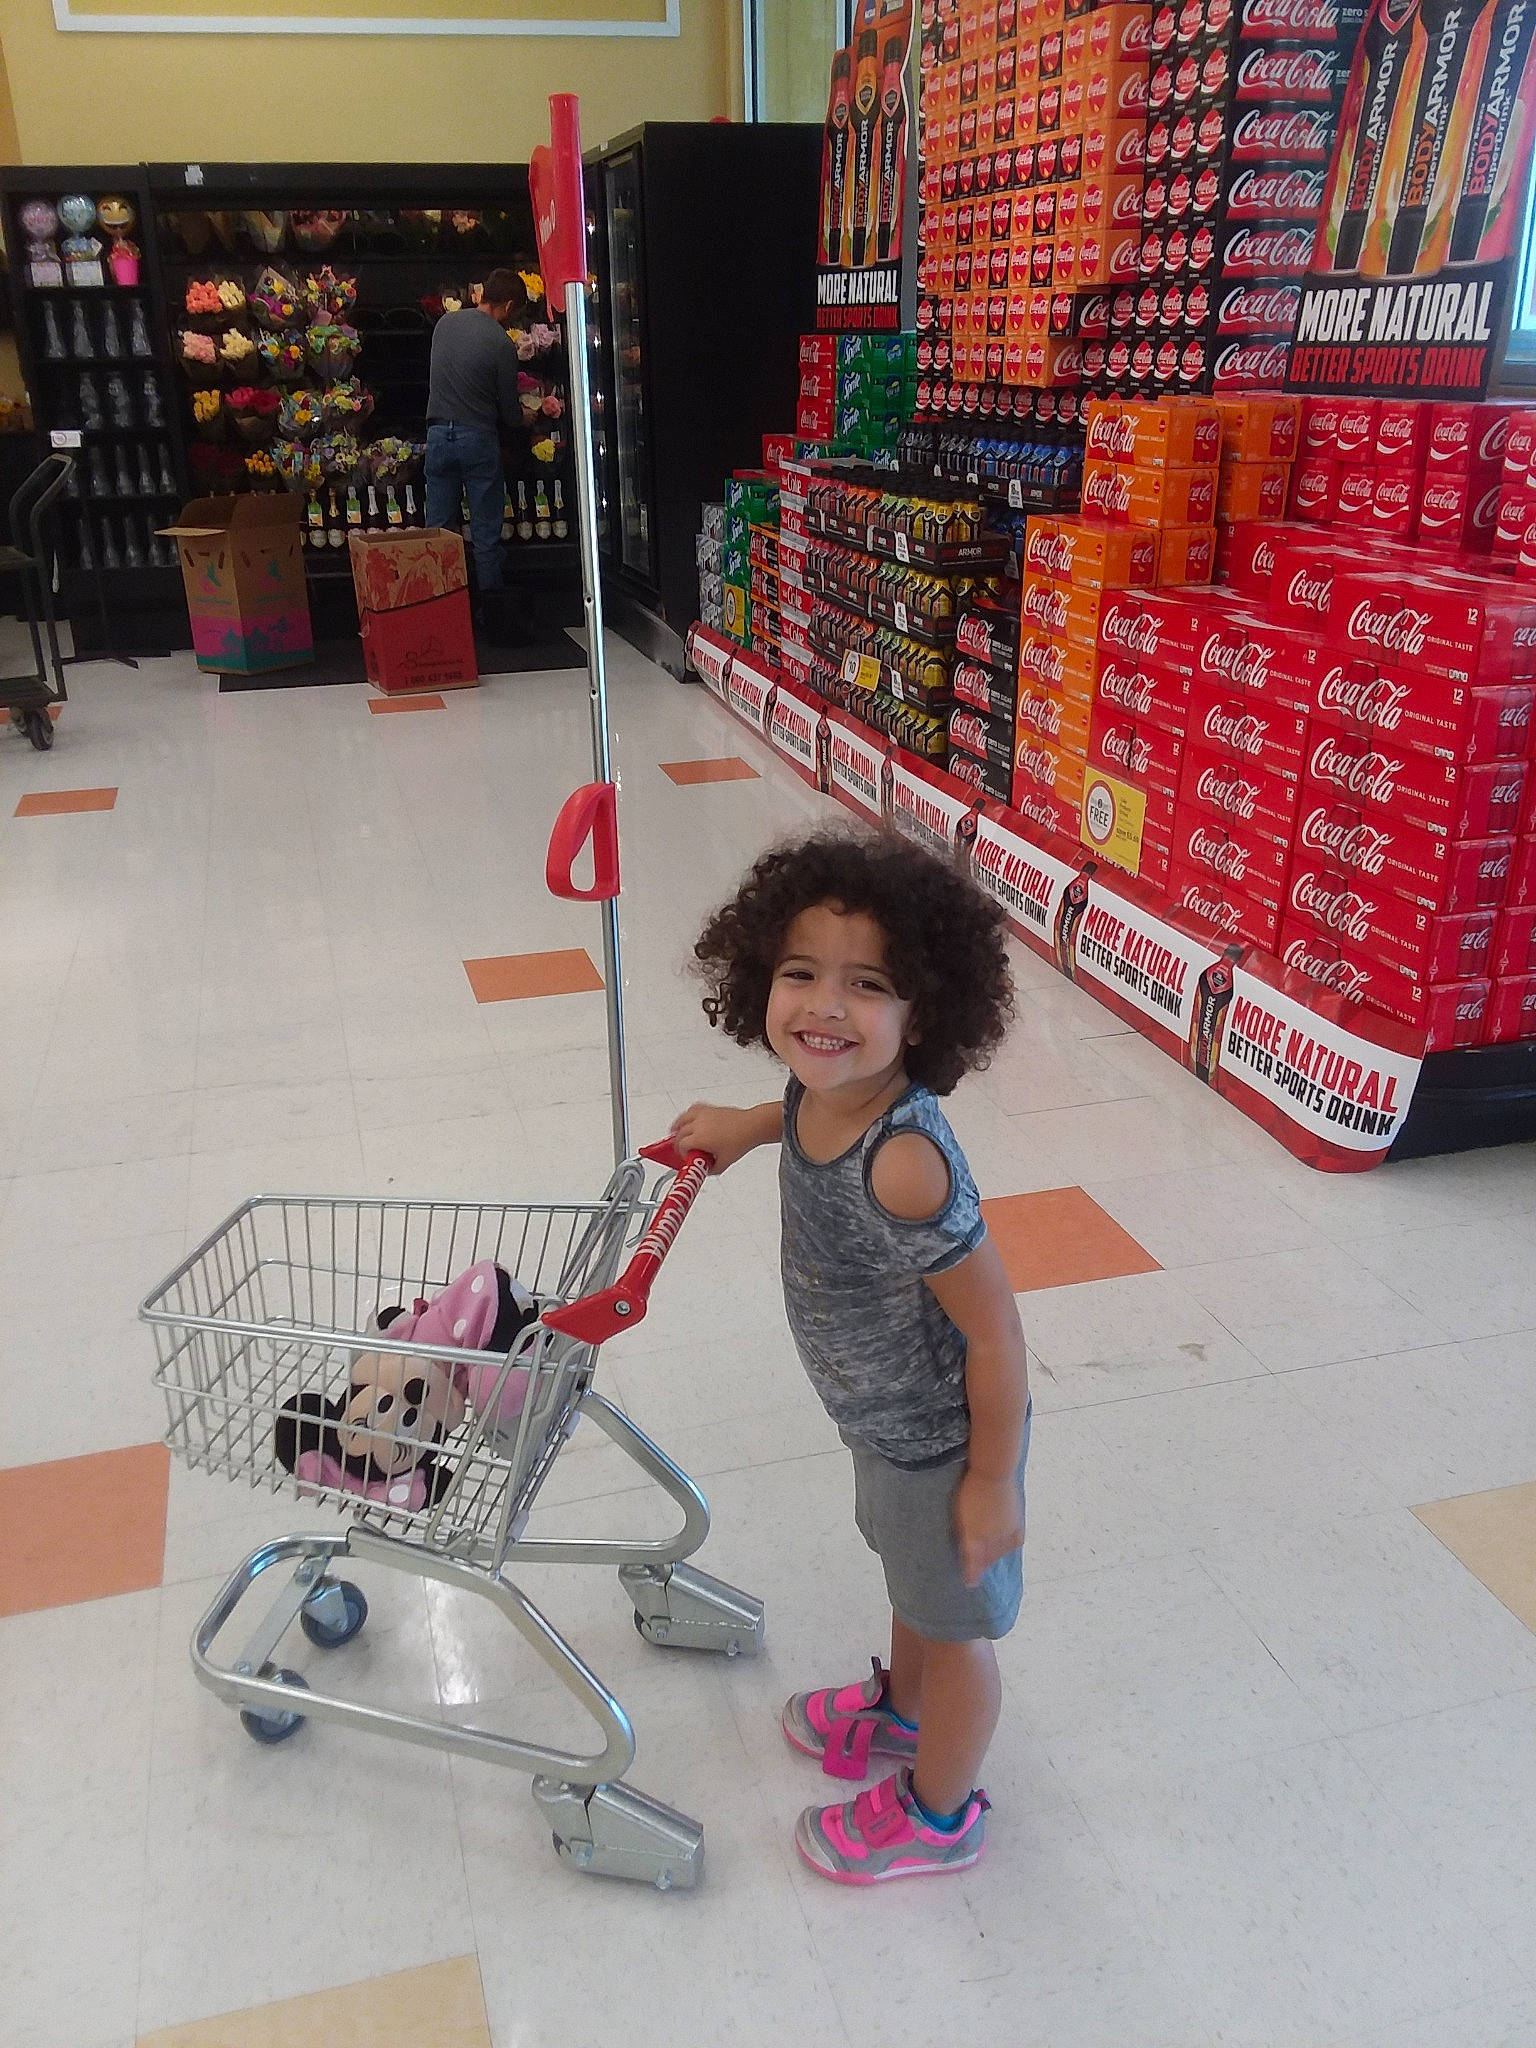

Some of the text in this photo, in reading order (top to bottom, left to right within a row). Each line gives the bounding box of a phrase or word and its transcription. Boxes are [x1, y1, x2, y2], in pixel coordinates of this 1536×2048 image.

[1237, 48, 1340, 89] Coca-Cola
[1406, 7, 1463, 207] BODYARMOR
[1468, 1, 1528, 196] BODYARMOR
[1233, 109, 1335, 149] Coca-Cola
[1352, 40, 1399, 211] BODYARMOR
[1228, 169, 1329, 208] Coca-Cola
[817, 269, 898, 304] MORE NATURAL
[1297, 281, 1493, 342] MORE NATURAL
[1290, 347, 1487, 388] BETTER SPORTS DRINK
[1103, 605, 1164, 655] Coca-Cola
[1348, 600, 1473, 656] Coca-Cola ORIGINAL TASTE
[1467, 608, 1478, 621] 12
[1200, 633, 1275, 689] Coca-Cola
[1308, 650, 1316, 662] 12
[1100, 664, 1157, 714] Coca-Cola
[1317, 666, 1457, 731] Coca-Cola ORIGINAL TASTE
[1453, 688, 1464, 702] 12
[1204, 704, 1269, 756] Coca-Cola
[1296, 719, 1304, 732] 12
[832, 735, 877, 786] MORE NATURAL
[1310, 737, 1450, 807] Coca-Cola ORIGINAL TASTE
[1445, 766, 1456, 780] 12
[895, 779, 915, 812] MORE
[915, 793, 950, 838] NATURAL
[1089, 806, 1110, 828] FREE
[1196, 768, 1261, 819] Coca-Cola
[1286, 787, 1294, 799] 12
[1188, 828, 1251, 881] Coca-Cola
[1276, 852, 1284, 863] 12
[1301, 807, 1439, 883] Coca-Cola ORIGINAL TASTE
[1435, 843, 1446, 856] 12
[973, 834, 1055, 909] MORE NATURAL
[998, 878, 1048, 927] SPORTS DRINK
[1292, 872, 1420, 953] Coca-Cola ORIGINAL TASTE
[1416, 914, 1426, 928] 12
[1083, 904, 1189, 995] MORE NATURAL
[1080, 934, 1184, 1019] BETTER SPORTS DRINK
[1411, 986, 1422, 999] 12
[1366, 995, 1394, 1014] ORIGINAL
[1396, 1011, 1416, 1024] TASTE
[1230, 996, 1399, 1115] MORE NATURAL
[1227, 1031, 1397, 1137] BETTER SPORTS DRINK
